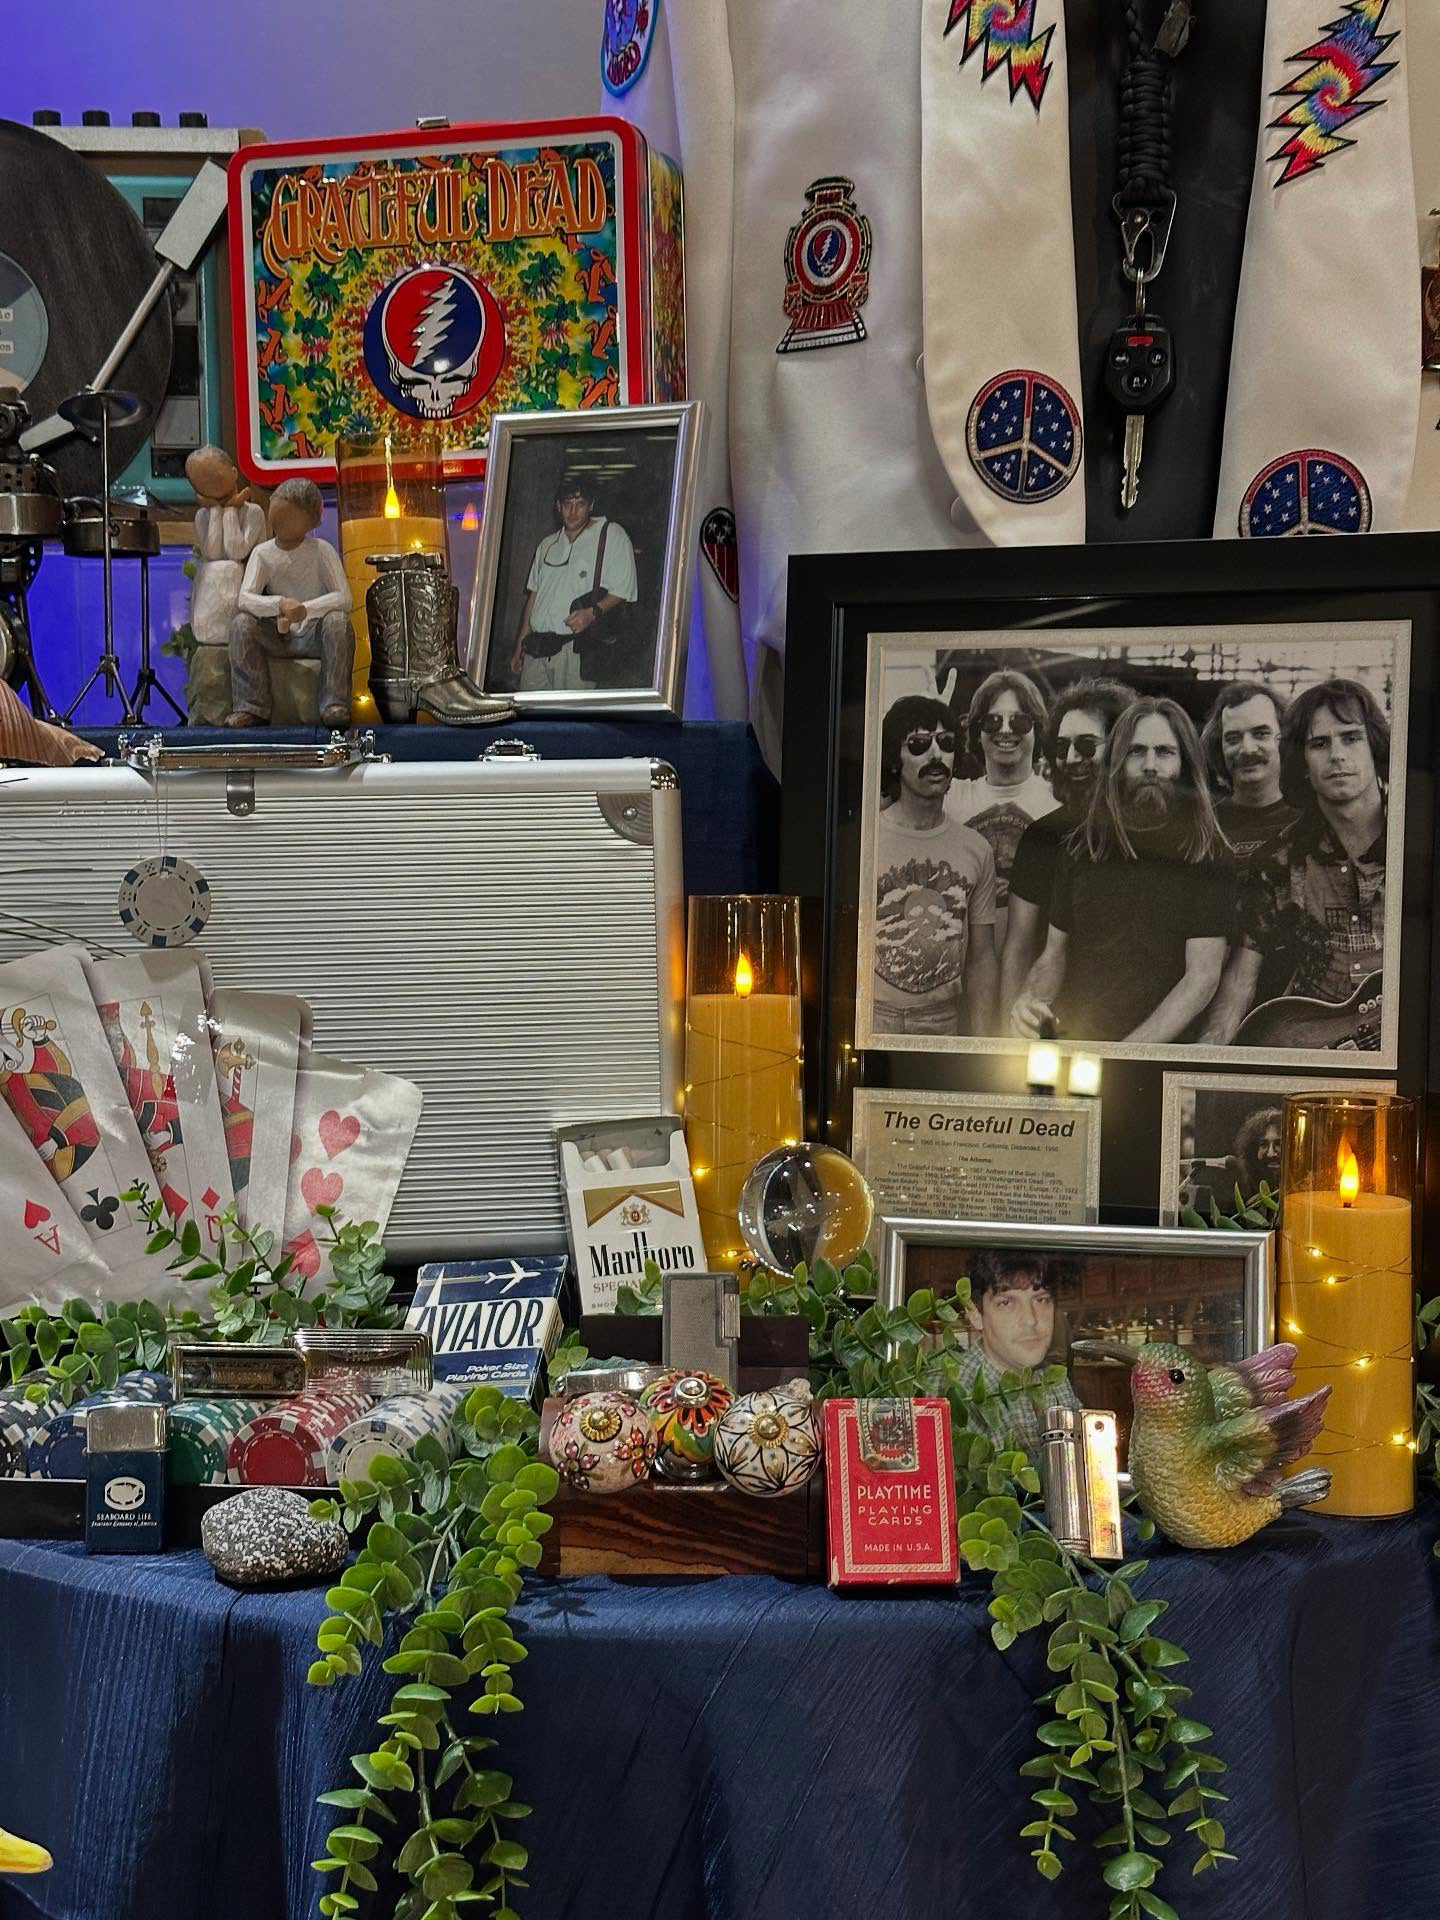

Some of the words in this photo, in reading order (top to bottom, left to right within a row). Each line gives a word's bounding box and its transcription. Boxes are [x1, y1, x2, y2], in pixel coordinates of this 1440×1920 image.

[262, 167, 479, 279] GRATEFUL
[484, 158, 607, 243] DEAD
[884, 1111, 921, 1129] The
[928, 1113, 1013, 1135] Grateful
[1019, 1117, 1076, 1138] Dead
[34, 1224, 61, 1255] A
[588, 1231, 695, 1278] Marlboro
[414, 1299, 544, 1353] AVIATOR
[466, 1363, 500, 1373] Poker
[503, 1362, 529, 1370] Size
[445, 1373, 488, 1382] Playing
[490, 1371, 527, 1379] Cards
[857, 1484, 932, 1500] PLAYTIME
[858, 1504, 933, 1515] PLAYING
[868, 1516, 923, 1526] CARDS
[864, 1543, 890, 1552] MADE
[892, 1543, 902, 1551] IN
[906, 1542, 933, 1551] U.S.A.
